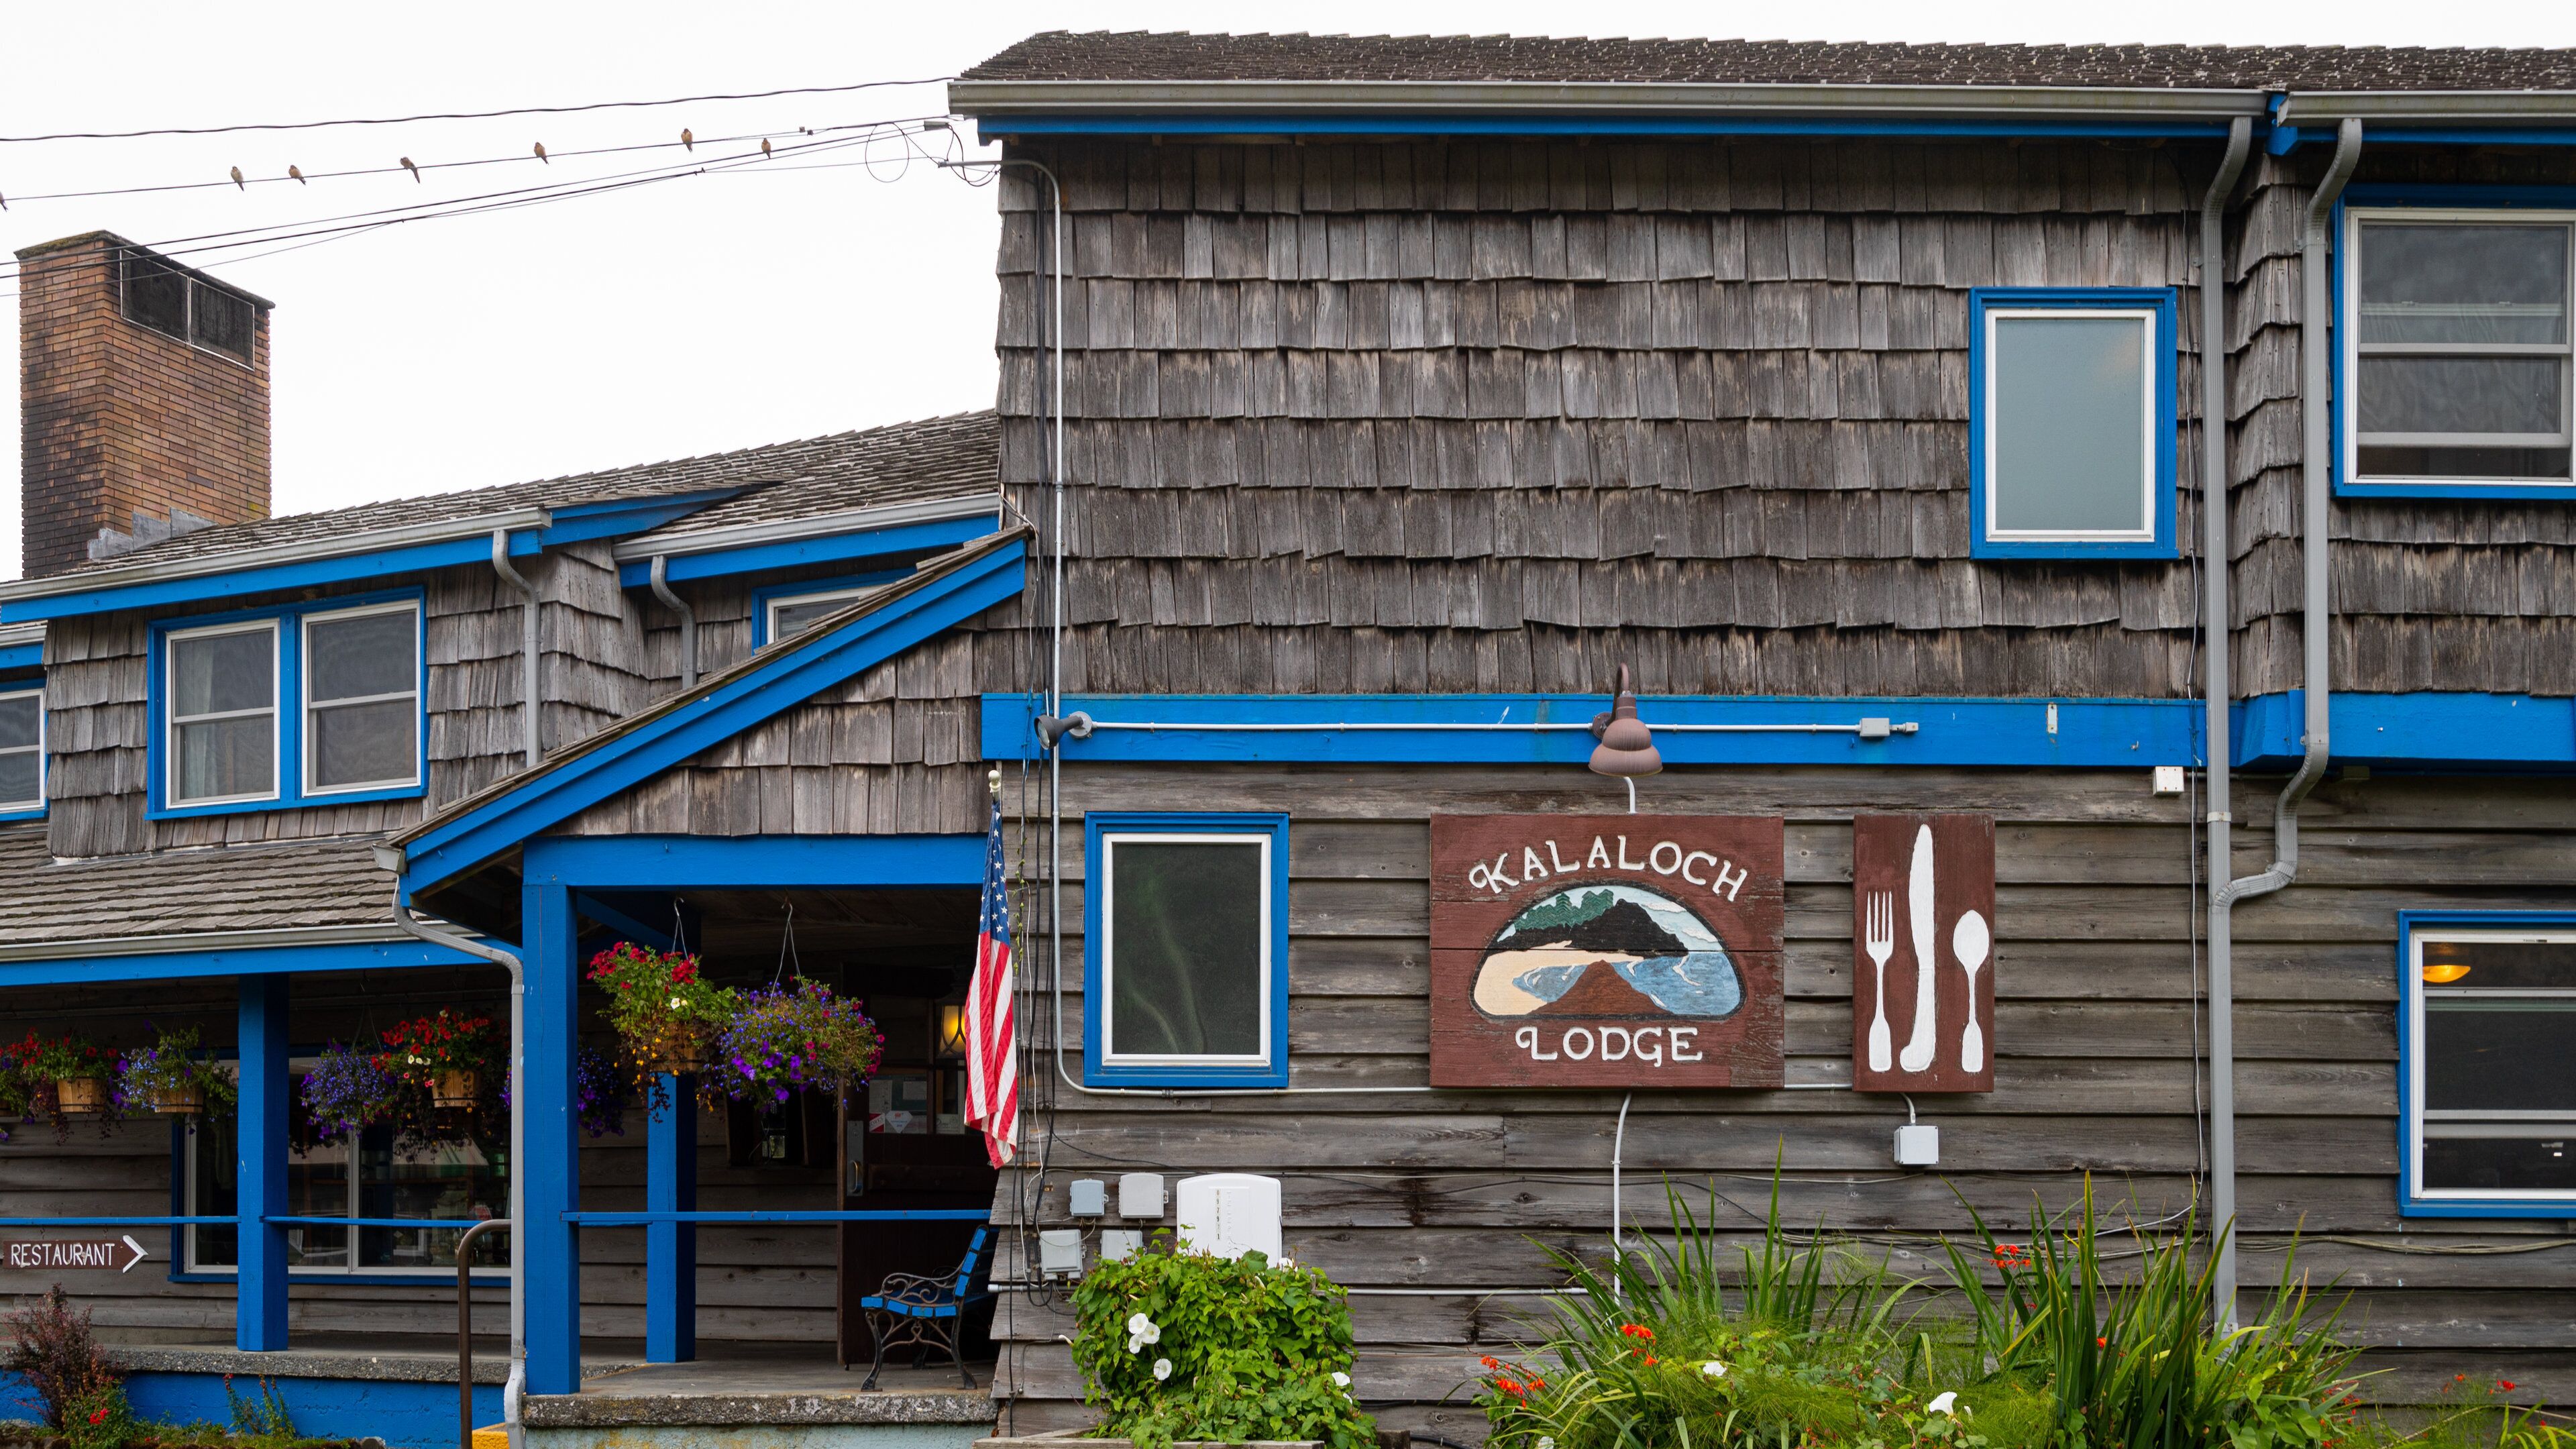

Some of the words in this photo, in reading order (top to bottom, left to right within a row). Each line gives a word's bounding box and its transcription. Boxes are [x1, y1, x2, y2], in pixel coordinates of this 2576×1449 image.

[1468, 835, 1748, 902] KALALOCH
[1515, 1026, 1703, 1067] LODGE
[11, 1243, 115, 1267] RESTAURANT
